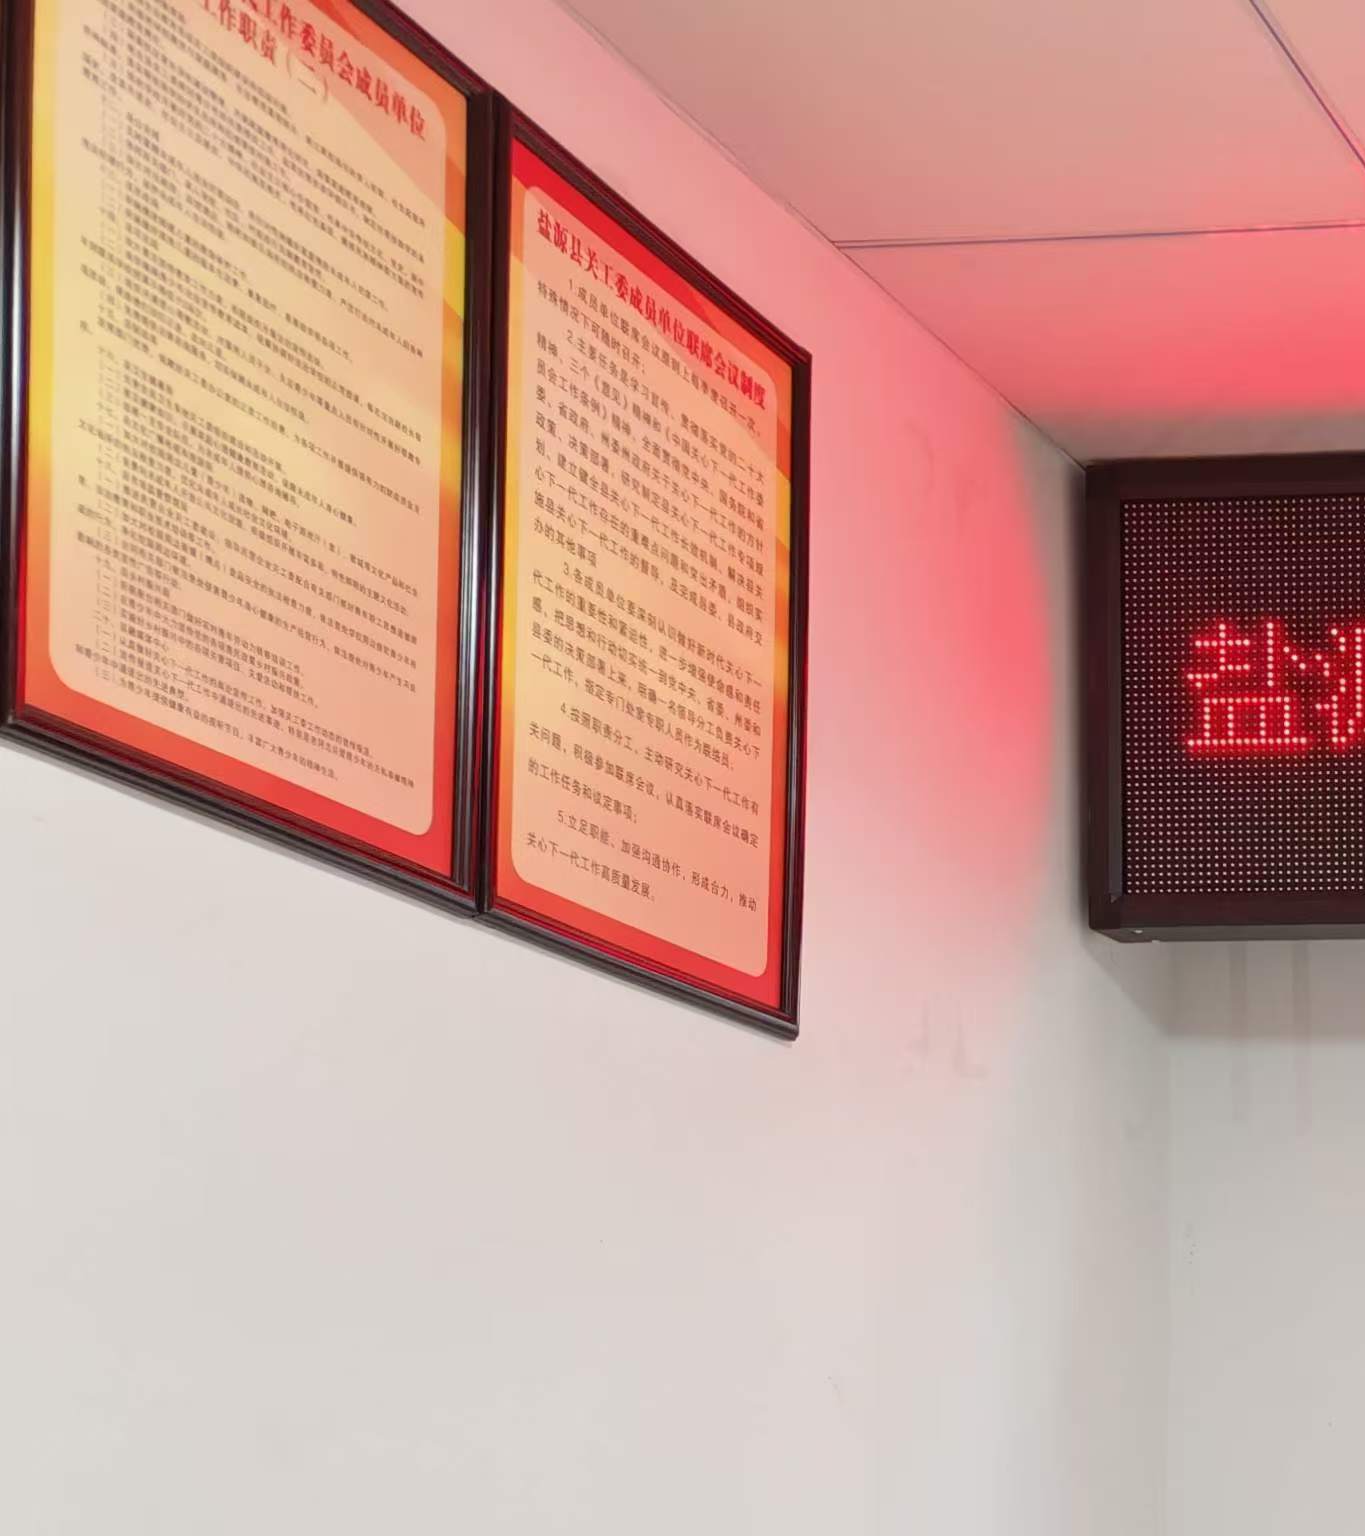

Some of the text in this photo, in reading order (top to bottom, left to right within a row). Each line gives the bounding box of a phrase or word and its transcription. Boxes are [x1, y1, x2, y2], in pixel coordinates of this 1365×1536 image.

[536, 205, 766, 412] 盐源县关工委成员单位联席会议制度
